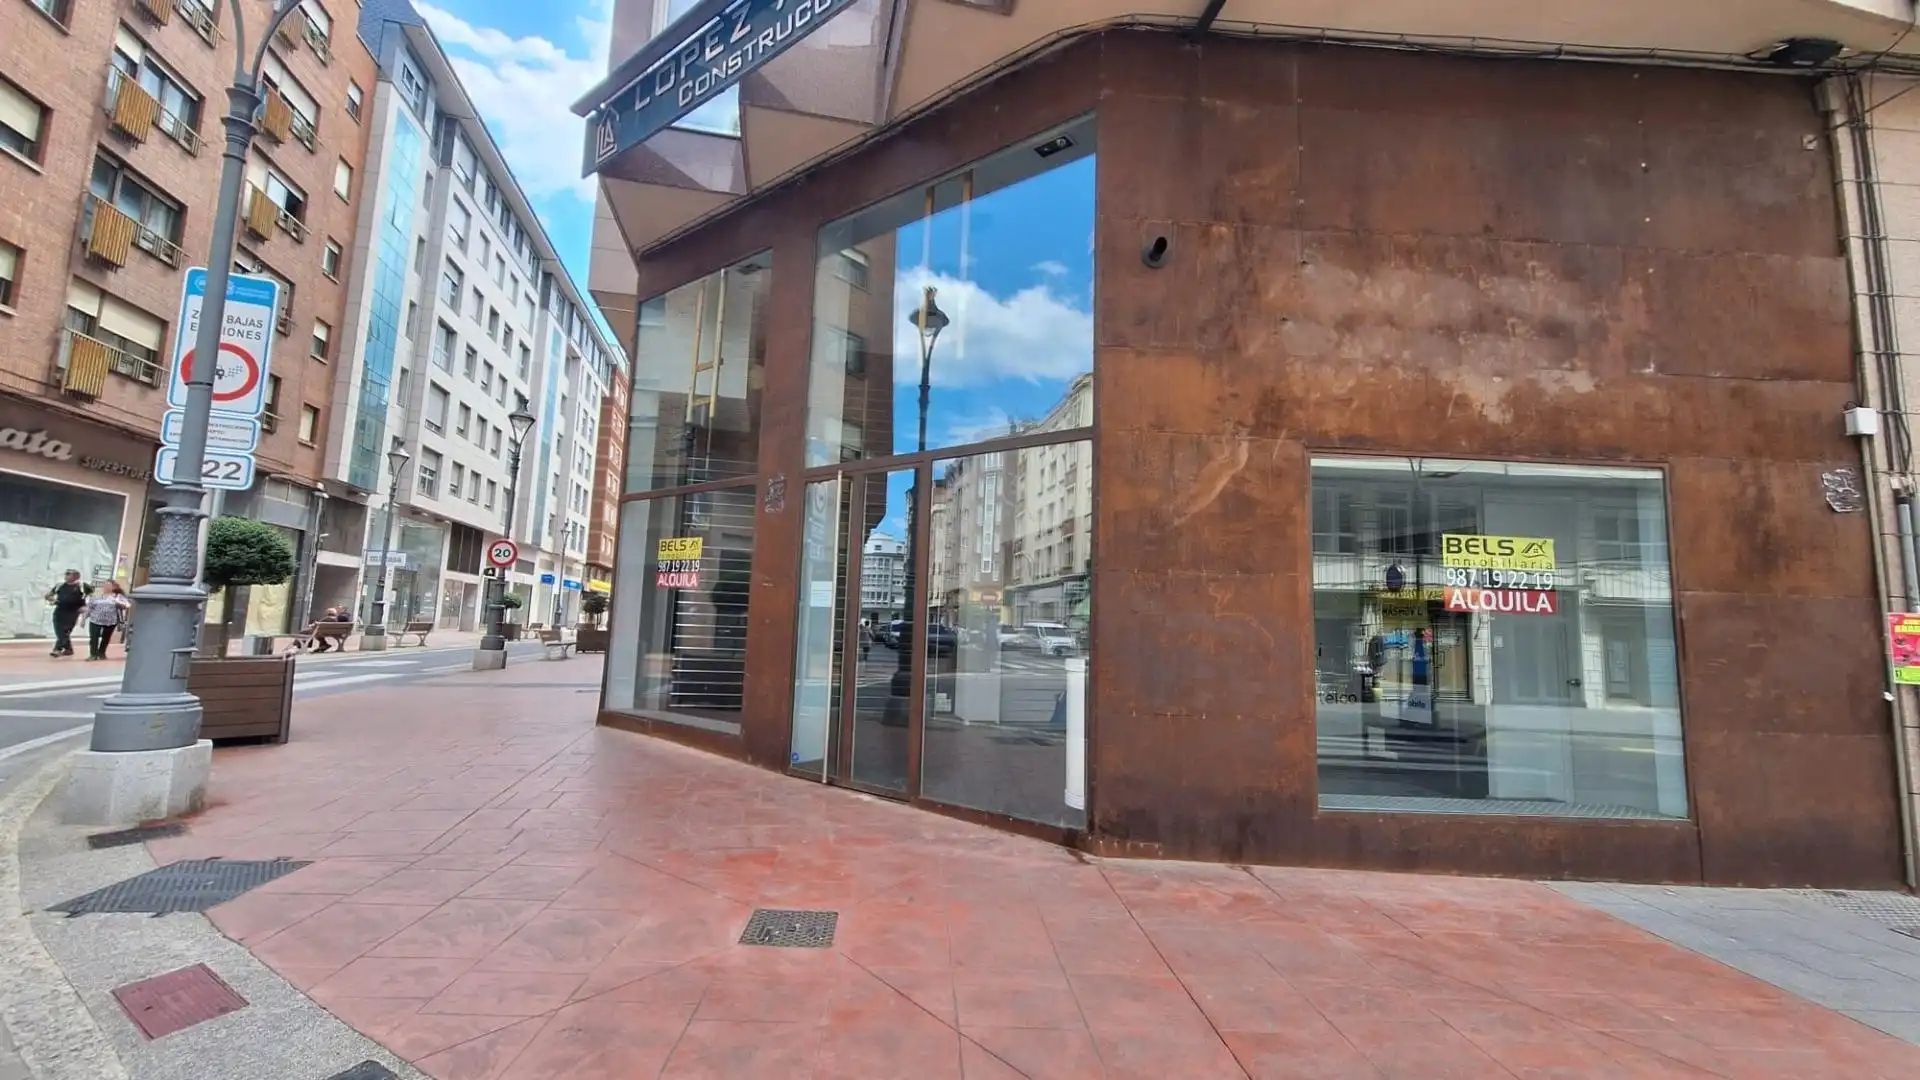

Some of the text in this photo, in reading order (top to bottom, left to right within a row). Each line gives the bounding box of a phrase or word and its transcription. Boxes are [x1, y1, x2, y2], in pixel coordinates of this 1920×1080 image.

[226, 315, 264, 329] BAJAS
[82, 456, 153, 481] SUPERSTORE
[494, 548, 511, 558] 20
[660, 540, 687, 552] BELS
[1446, 537, 1515, 556] BELS
[658, 559, 700, 572] 987 19 22 19
[657, 573, 697, 587] ALQUILA
[1446, 568, 1554, 591] 987 19 22 19
[1449, 589, 1553, 613] ALQUILA
